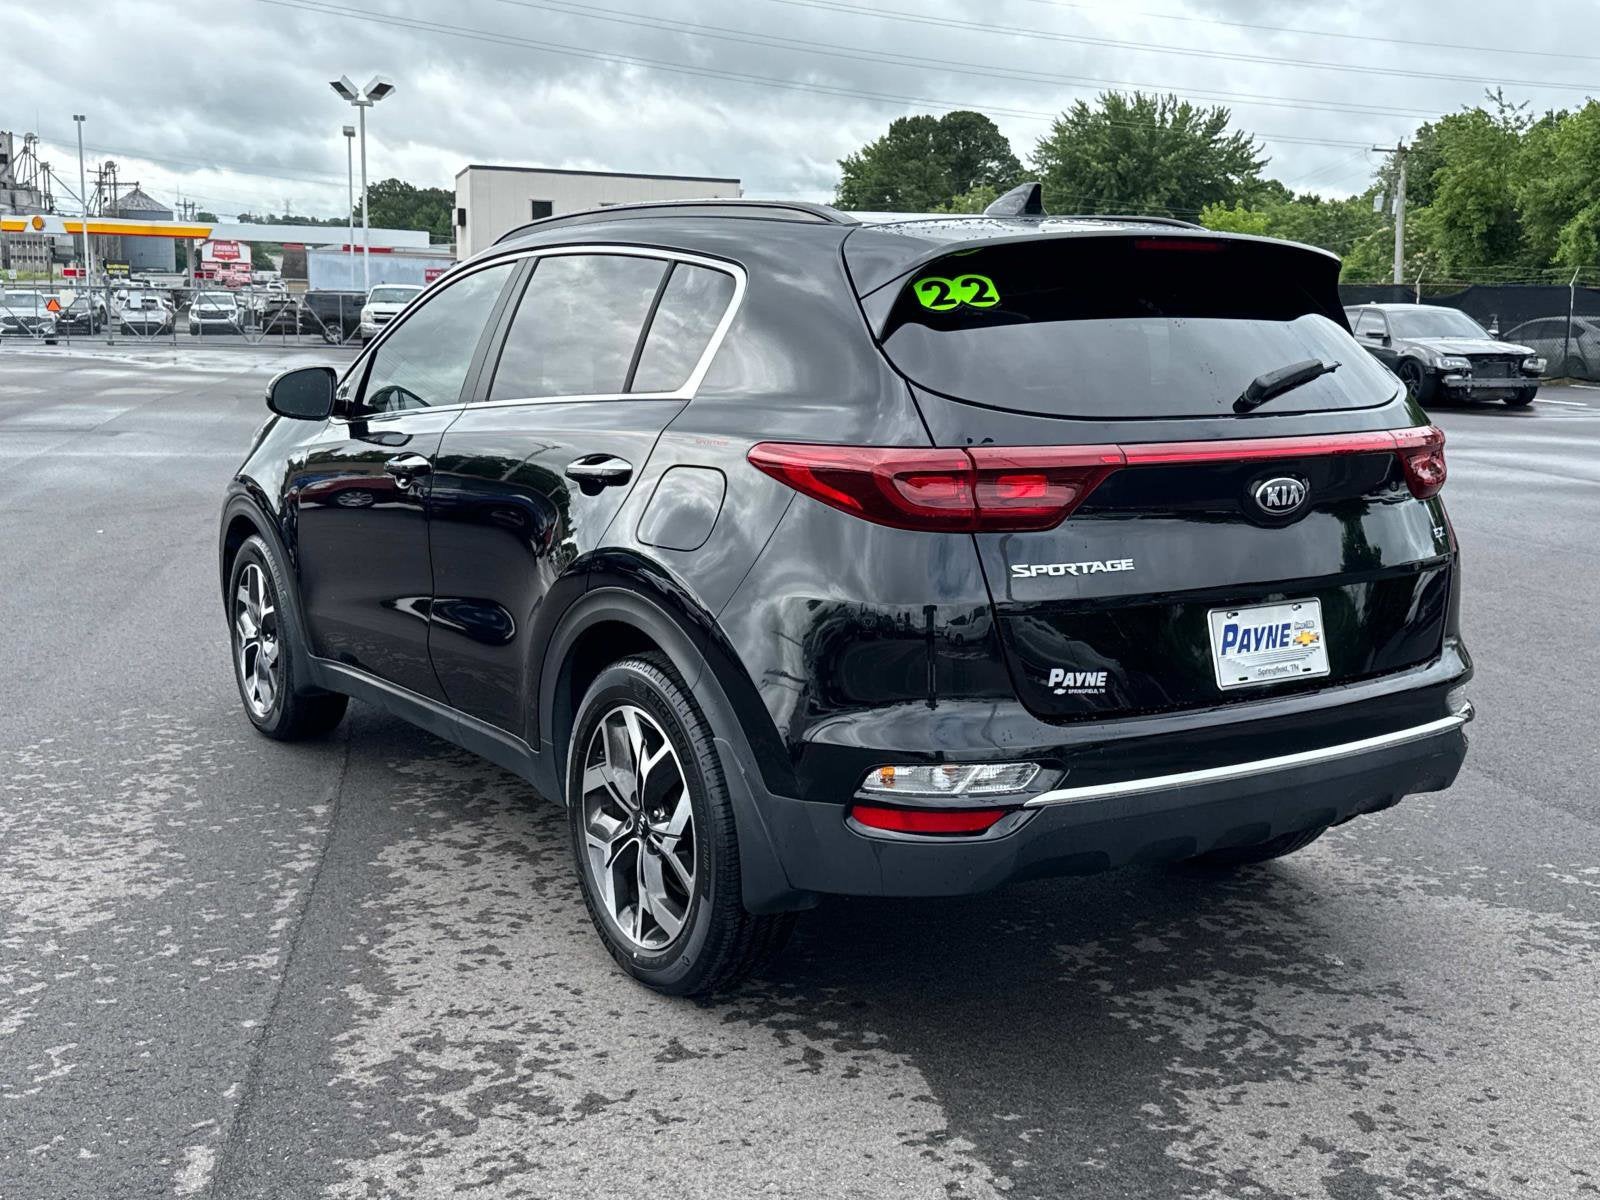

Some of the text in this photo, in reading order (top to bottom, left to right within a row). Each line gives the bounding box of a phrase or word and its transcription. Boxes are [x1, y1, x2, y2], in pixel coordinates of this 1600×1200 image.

[920, 277, 997, 308] 22
[1266, 485, 1300, 506] KIA
[1010, 558, 1135, 578] SPORTAGE
[1221, 623, 1292, 656] PAYNE
[1048, 668, 1108, 687] PAYNE
